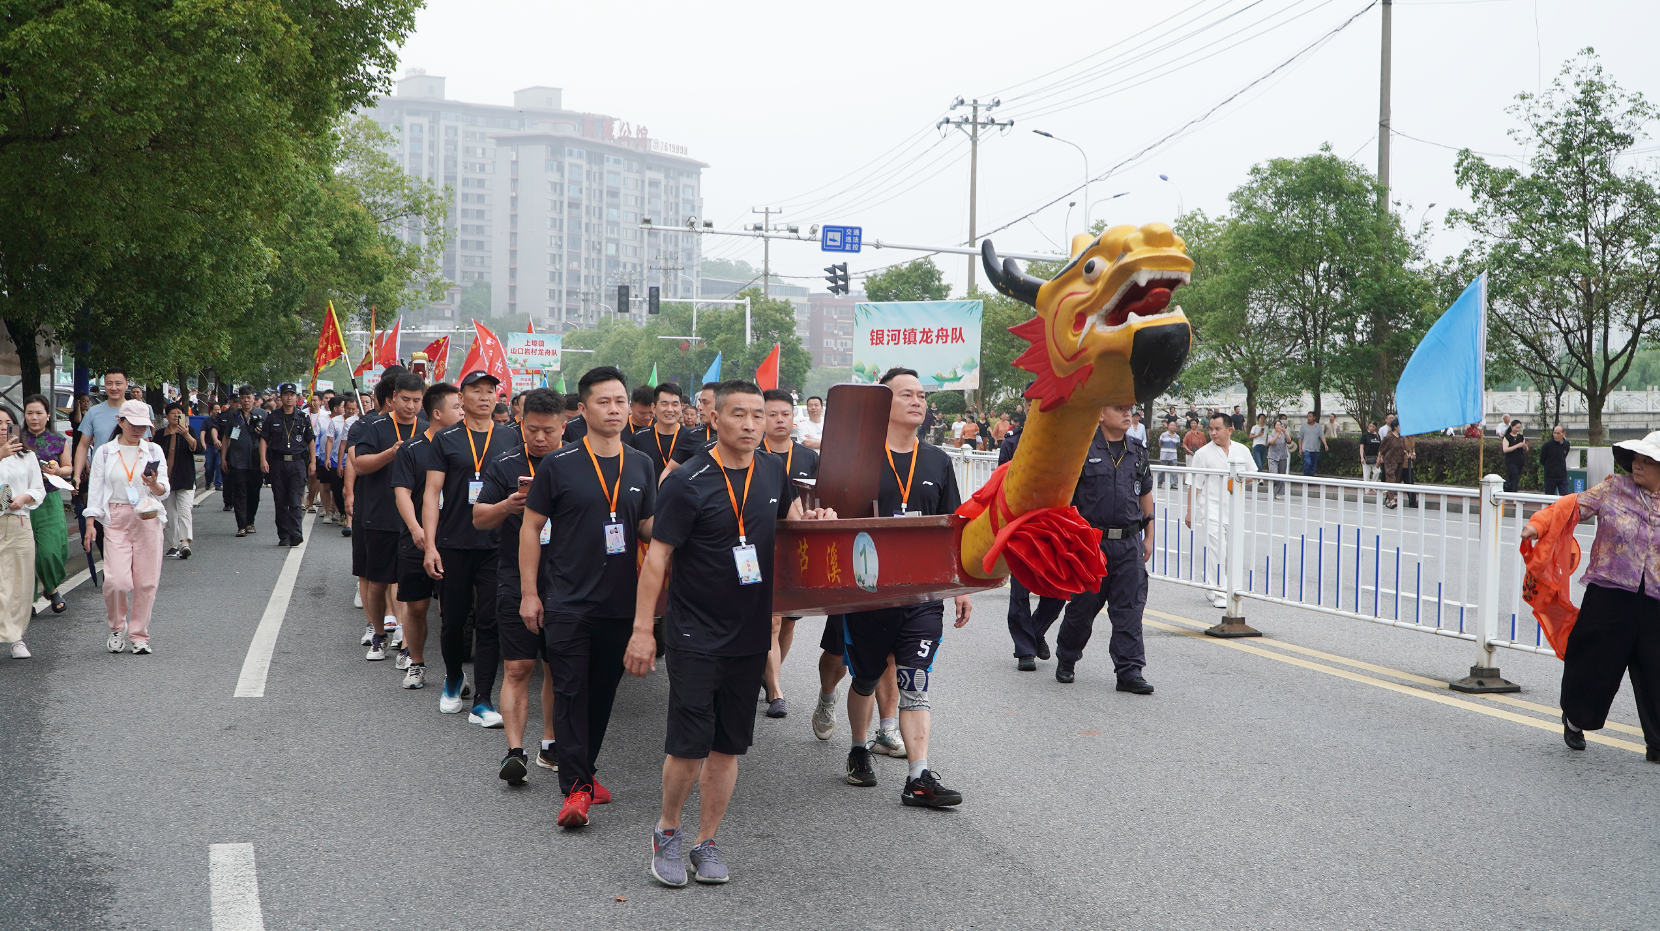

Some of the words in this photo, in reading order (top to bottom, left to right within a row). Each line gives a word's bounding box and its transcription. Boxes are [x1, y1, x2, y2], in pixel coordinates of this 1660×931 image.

[524, 339, 545, 347] 上埠镇
[870, 327, 965, 346] 银河镇龙舟队
[510, 347, 558, 356] 山口岩村龙舟队
[859, 543, 868, 575] 1
[917, 639, 932, 658] 5
